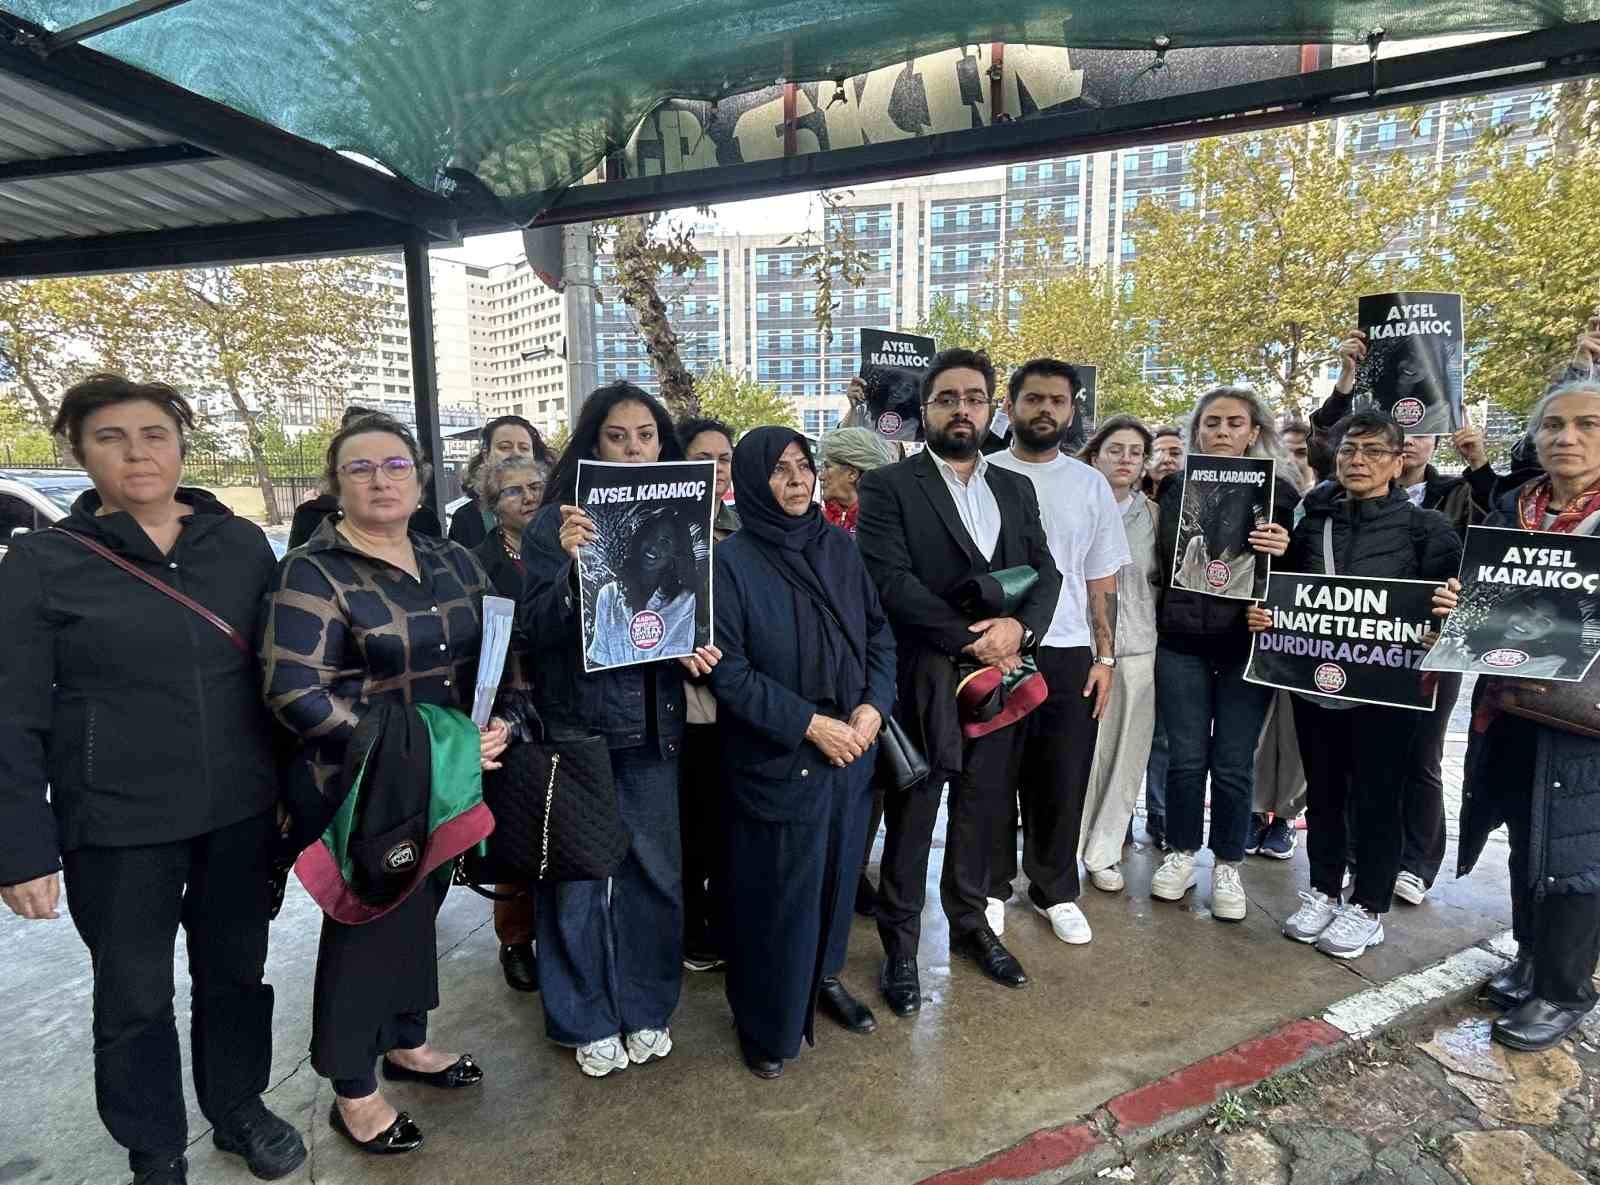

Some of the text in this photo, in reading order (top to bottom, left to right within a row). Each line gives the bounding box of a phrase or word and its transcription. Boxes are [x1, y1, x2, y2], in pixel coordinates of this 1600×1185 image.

[1386, 304, 1437, 321] AYSEL
[1369, 320, 1453, 340] KARAKOÇ
[881, 340, 917, 354] AYSEL
[1191, 469, 1265, 487] AYSEL KARAKOÇ
[587, 480, 706, 504] AYSEL KARAKOÇ
[1502, 546, 1576, 568] AYSEL
[1477, 565, 1600, 594] KARAKOÇ
[1295, 583, 1388, 615] KADIN
[1259, 632, 1426, 670] DURDURACAĞIZ
